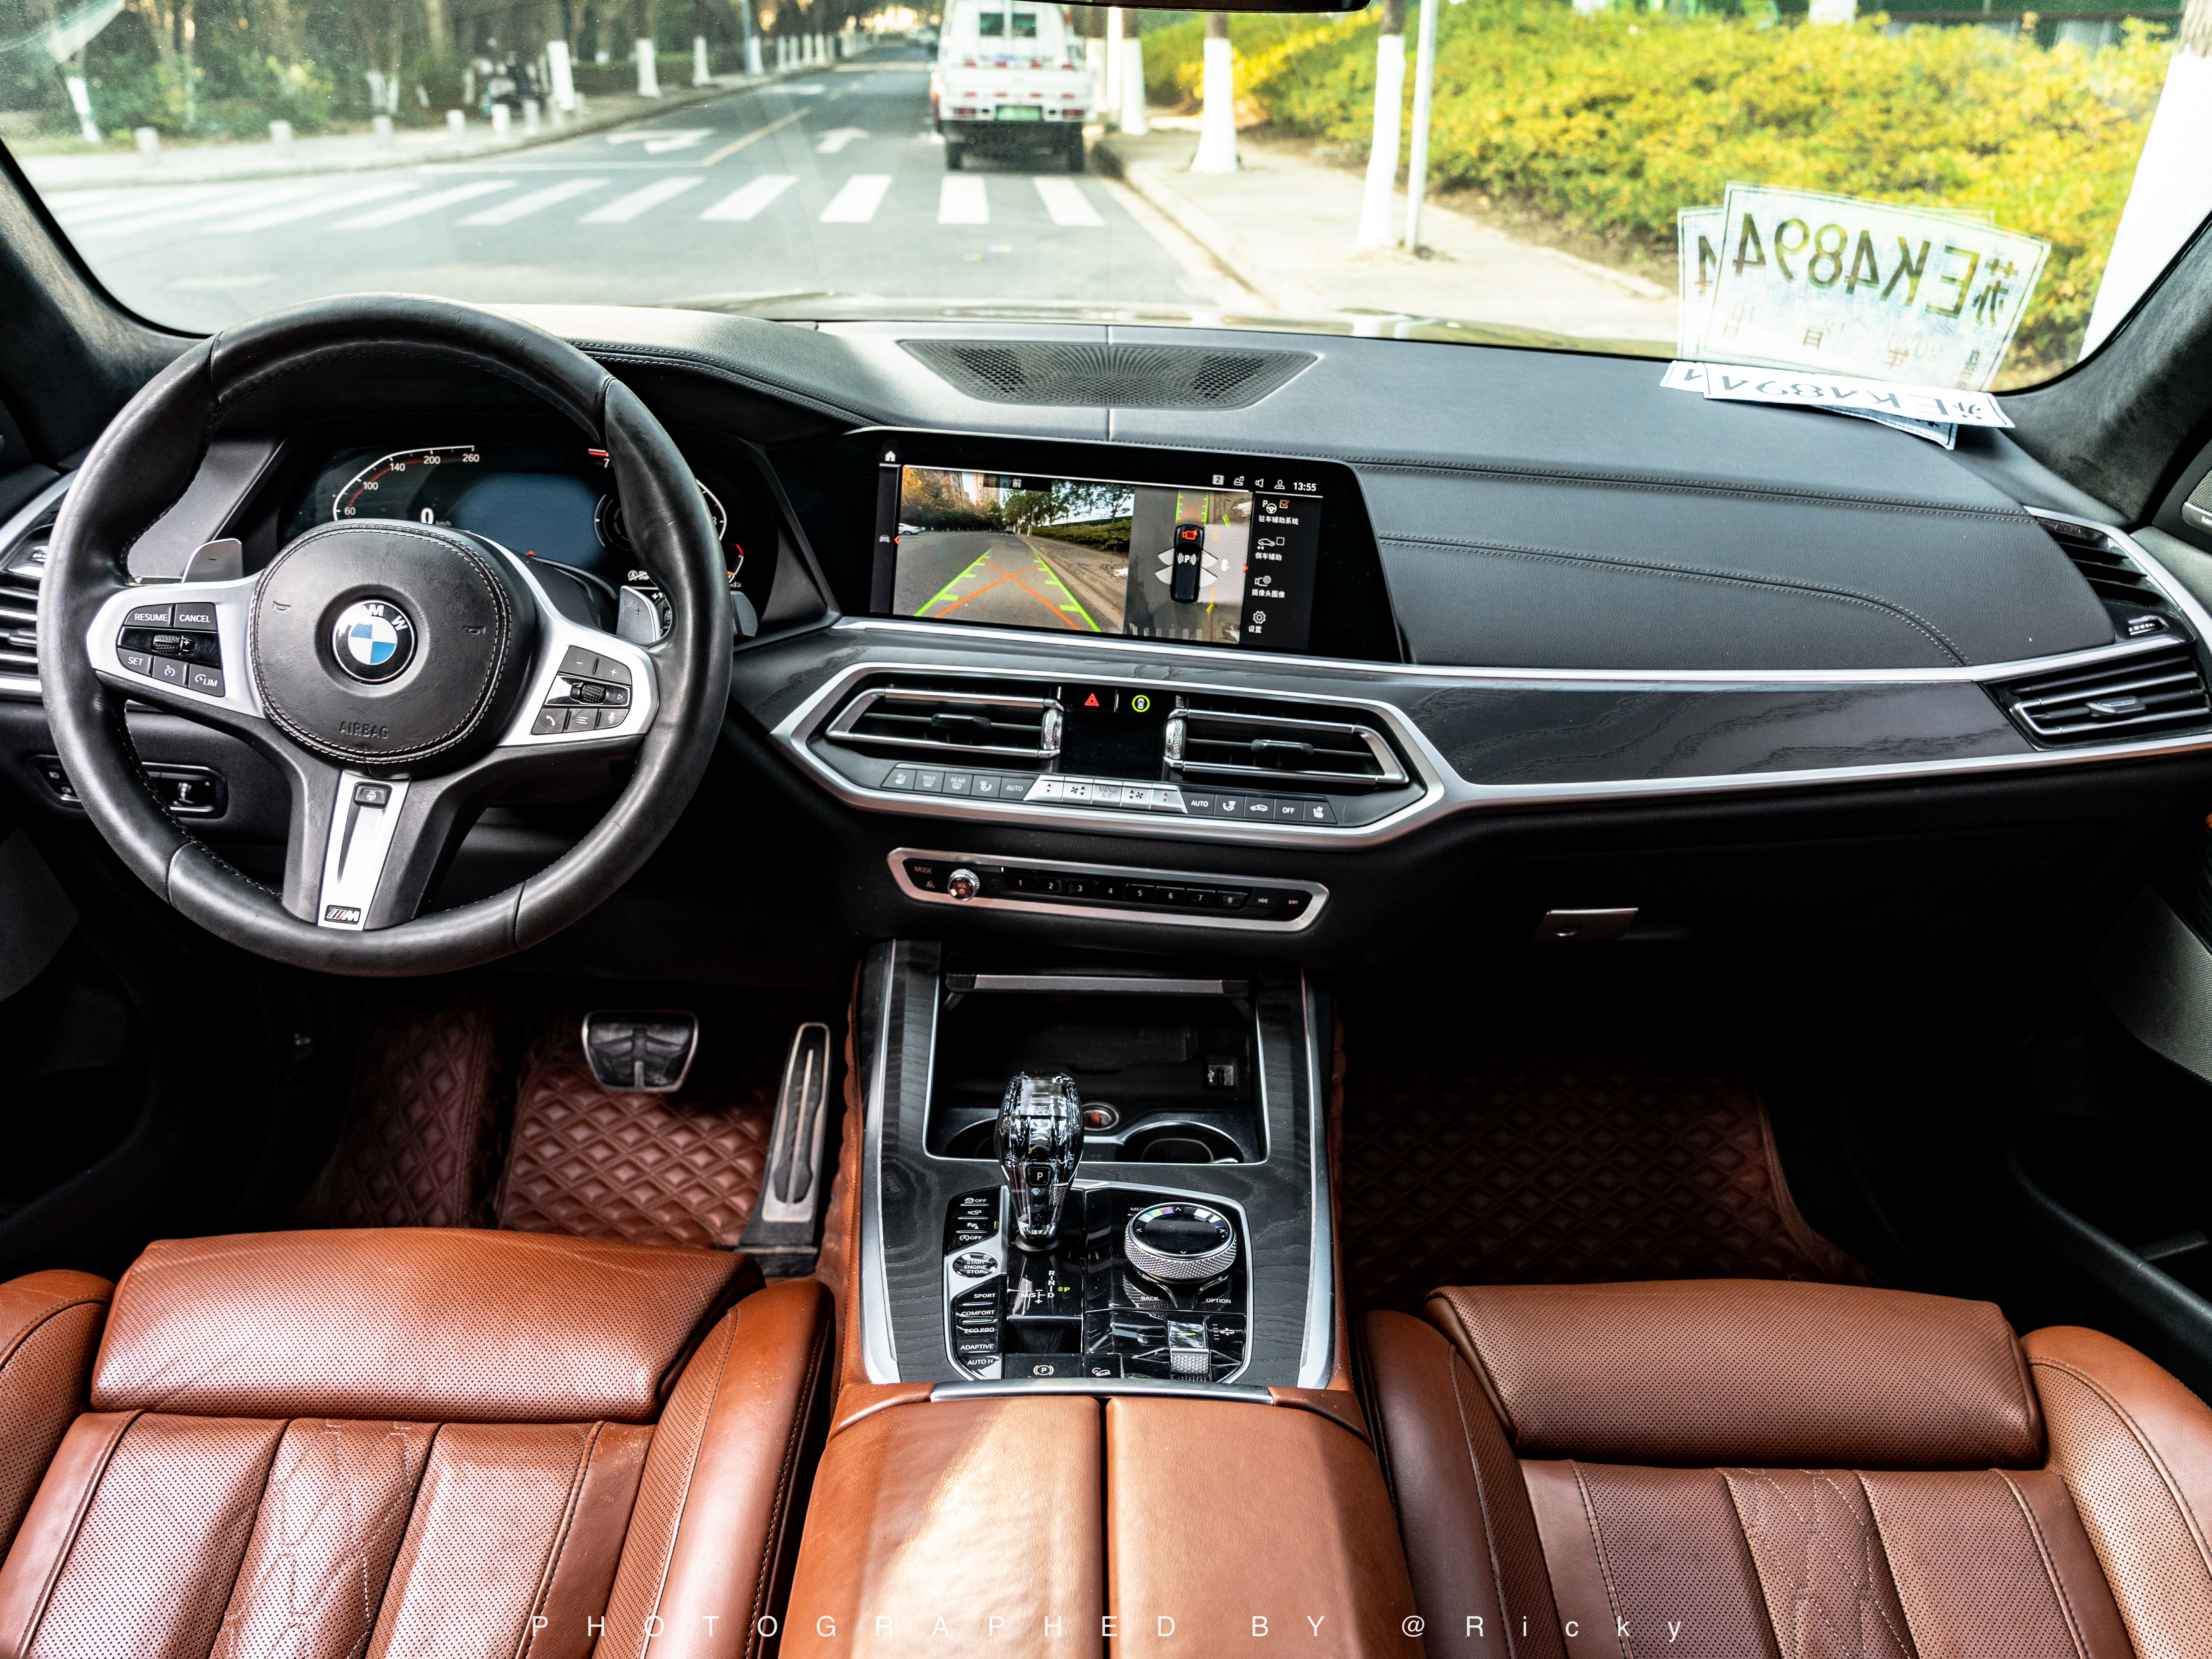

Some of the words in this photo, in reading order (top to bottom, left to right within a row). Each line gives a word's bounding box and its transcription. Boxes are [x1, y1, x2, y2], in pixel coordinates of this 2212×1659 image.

[423, 456, 440, 465] 200
[462, 454, 479, 462] 260
[390, 463, 405, 471] 140
[603, 458, 610, 468] 7
[363, 482, 378, 490] 100
[1012, 478, 1022, 488] 前
[1293, 482, 1316, 491] 13:55
[421, 508, 433, 524] 0
[1258, 515, 1299, 525] 驻车辅助系统
[134, 613, 168, 621] RESUME
[180, 615, 211, 623] CANCEL
[128, 656, 144, 666] SET
[203, 677, 218, 687] LIM
[340, 721, 389, 739] AIRBAG
[914, 866, 932, 874] MODE
[1037, 1172, 1044, 1180] P
